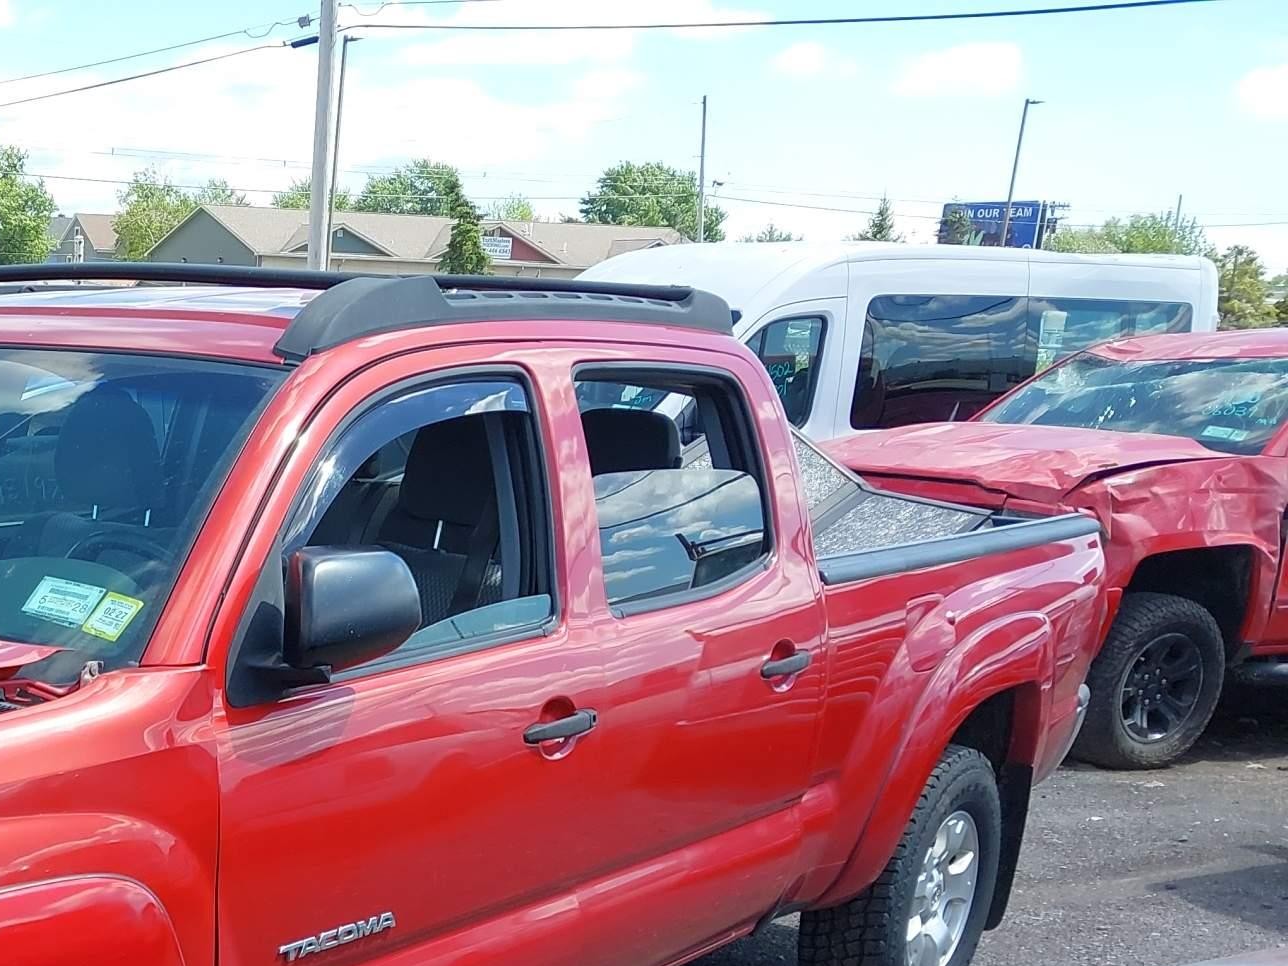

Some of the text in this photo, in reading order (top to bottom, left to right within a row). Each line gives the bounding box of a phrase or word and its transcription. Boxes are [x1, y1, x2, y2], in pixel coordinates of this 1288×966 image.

[977, 208, 999, 218] OUR
[38, 595, 47, 605] 5
[71, 602, 89, 614] 28
[279, 911, 396, 961] TACOMA
